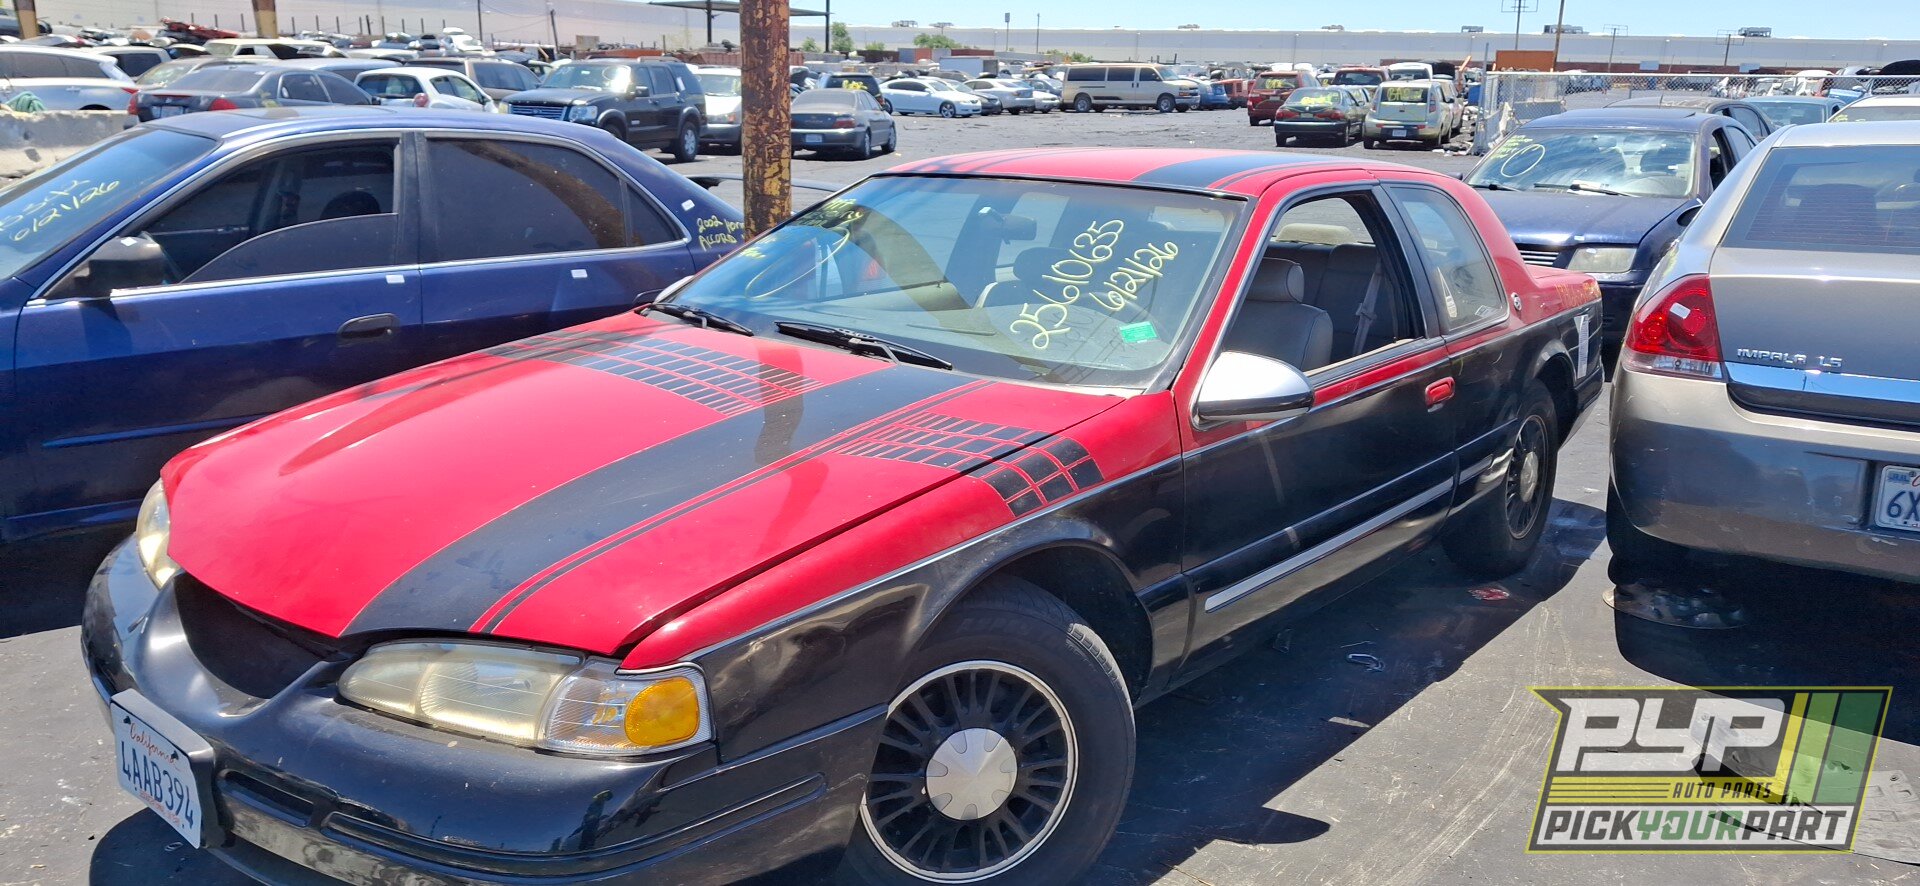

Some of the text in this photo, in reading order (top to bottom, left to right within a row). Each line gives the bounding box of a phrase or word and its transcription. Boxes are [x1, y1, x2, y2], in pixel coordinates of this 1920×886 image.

[697, 215, 723, 233] 2002
[1009, 219, 1125, 350] 25610635
[1088, 241, 1179, 311] 6/21/26
[1737, 348, 1843, 367] IMPALA LS
[121, 741, 194, 829] 4AAB394
